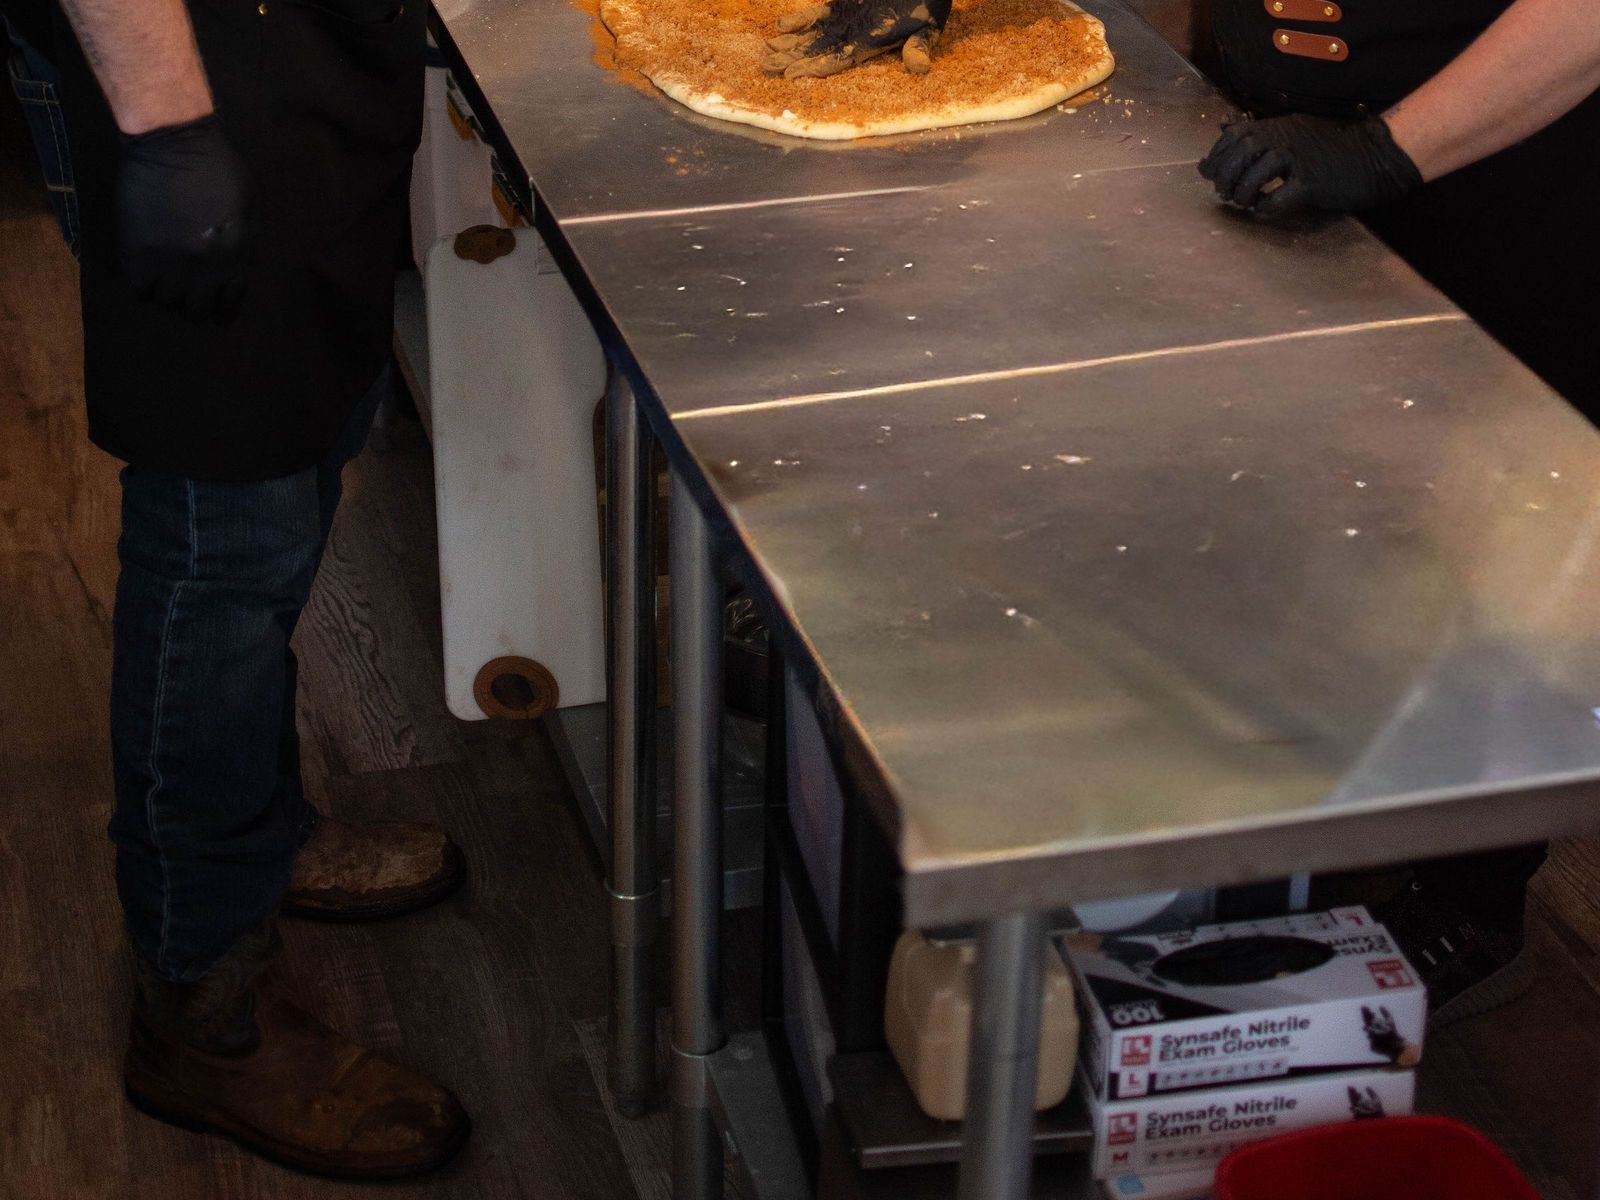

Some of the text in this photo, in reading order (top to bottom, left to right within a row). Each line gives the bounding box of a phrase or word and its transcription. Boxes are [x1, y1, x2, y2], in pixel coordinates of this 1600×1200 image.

[1113, 1005, 1164, 1025] 100
[1160, 1016, 1311, 1049] Synsafe Nitrile
[1159, 1044, 1216, 1062] Exam
[1222, 1035, 1291, 1054] Gloves
[1146, 1097, 1298, 1127] Synsafe Nitrile
[1145, 1114, 1278, 1140] Exam Gloves
[1113, 1152, 1128, 1162] M
